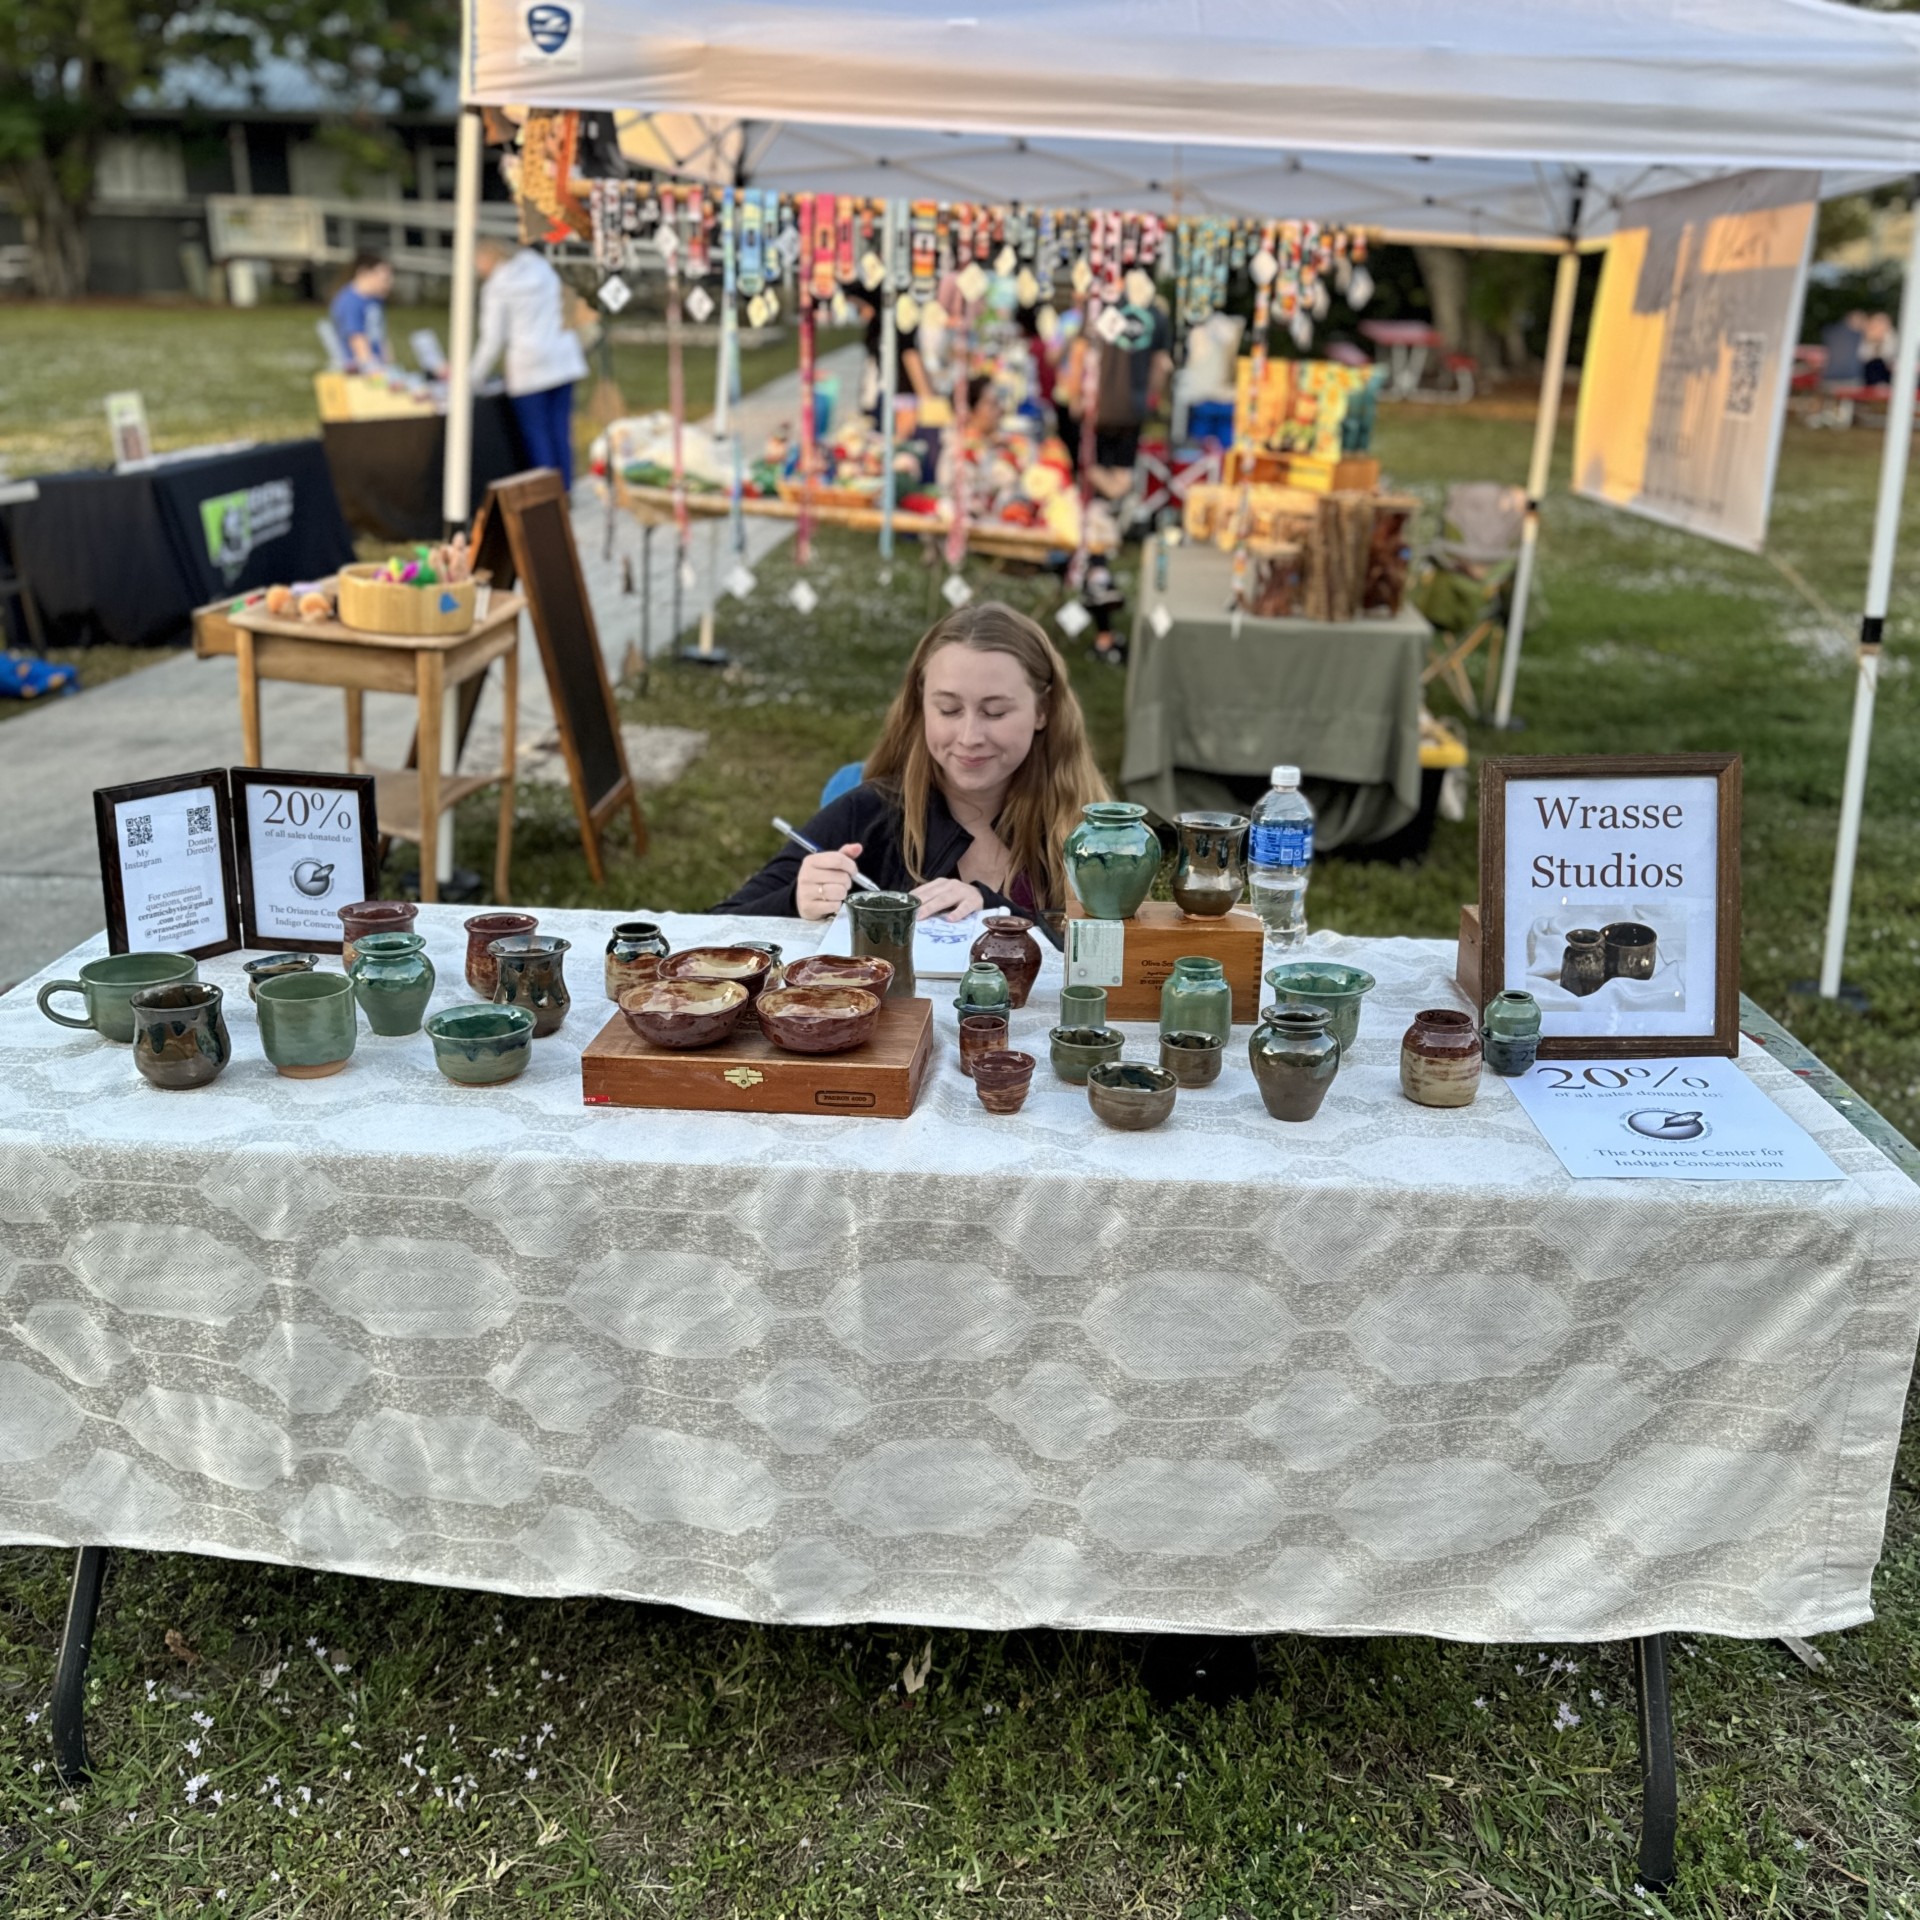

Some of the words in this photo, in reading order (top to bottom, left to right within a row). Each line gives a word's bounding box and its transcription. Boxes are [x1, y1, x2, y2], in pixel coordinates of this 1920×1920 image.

[262, 788, 352, 830] 20%
[1533, 796, 1684, 830] Wrasse
[187, 836, 214, 848] Donate
[264, 829, 274, 838] of
[275, 830, 286, 839] all
[287, 831, 307, 841] sales
[307, 832, 341, 843] donated
[342, 835, 354, 843] to:
[136, 848, 149, 858] My
[124, 857, 163, 871] Instagram
[1531, 852, 1684, 889] Studios
[147, 892, 162, 902] For
[182, 891, 203, 903] email
[175, 913, 184, 922] or
[184, 910, 198, 920] dm
[268, 904, 285, 914] The
[286, 905, 320, 917] Orianne
[320, 907, 337, 918] Cen
[200, 915, 210, 924] on
[275, 917, 302, 929] Indigo
[302, 918, 344, 930] Conservat
[1536, 1065, 1710, 1090] 20%
[1574, 1091, 1594, 1099] all
[1597, 1090, 1634, 1098] sales
[1636, 1089, 1697, 1099] donated
[1593, 1148, 1628, 1157] The
[1630, 1148, 1700, 1158] Orianne
[1701, 1148, 1756, 1158] Center
[1760, 1147, 1785, 1157] for
[1613, 1158, 1670, 1169] Indigo
[1672, 1158, 1785, 1169] Conservation
